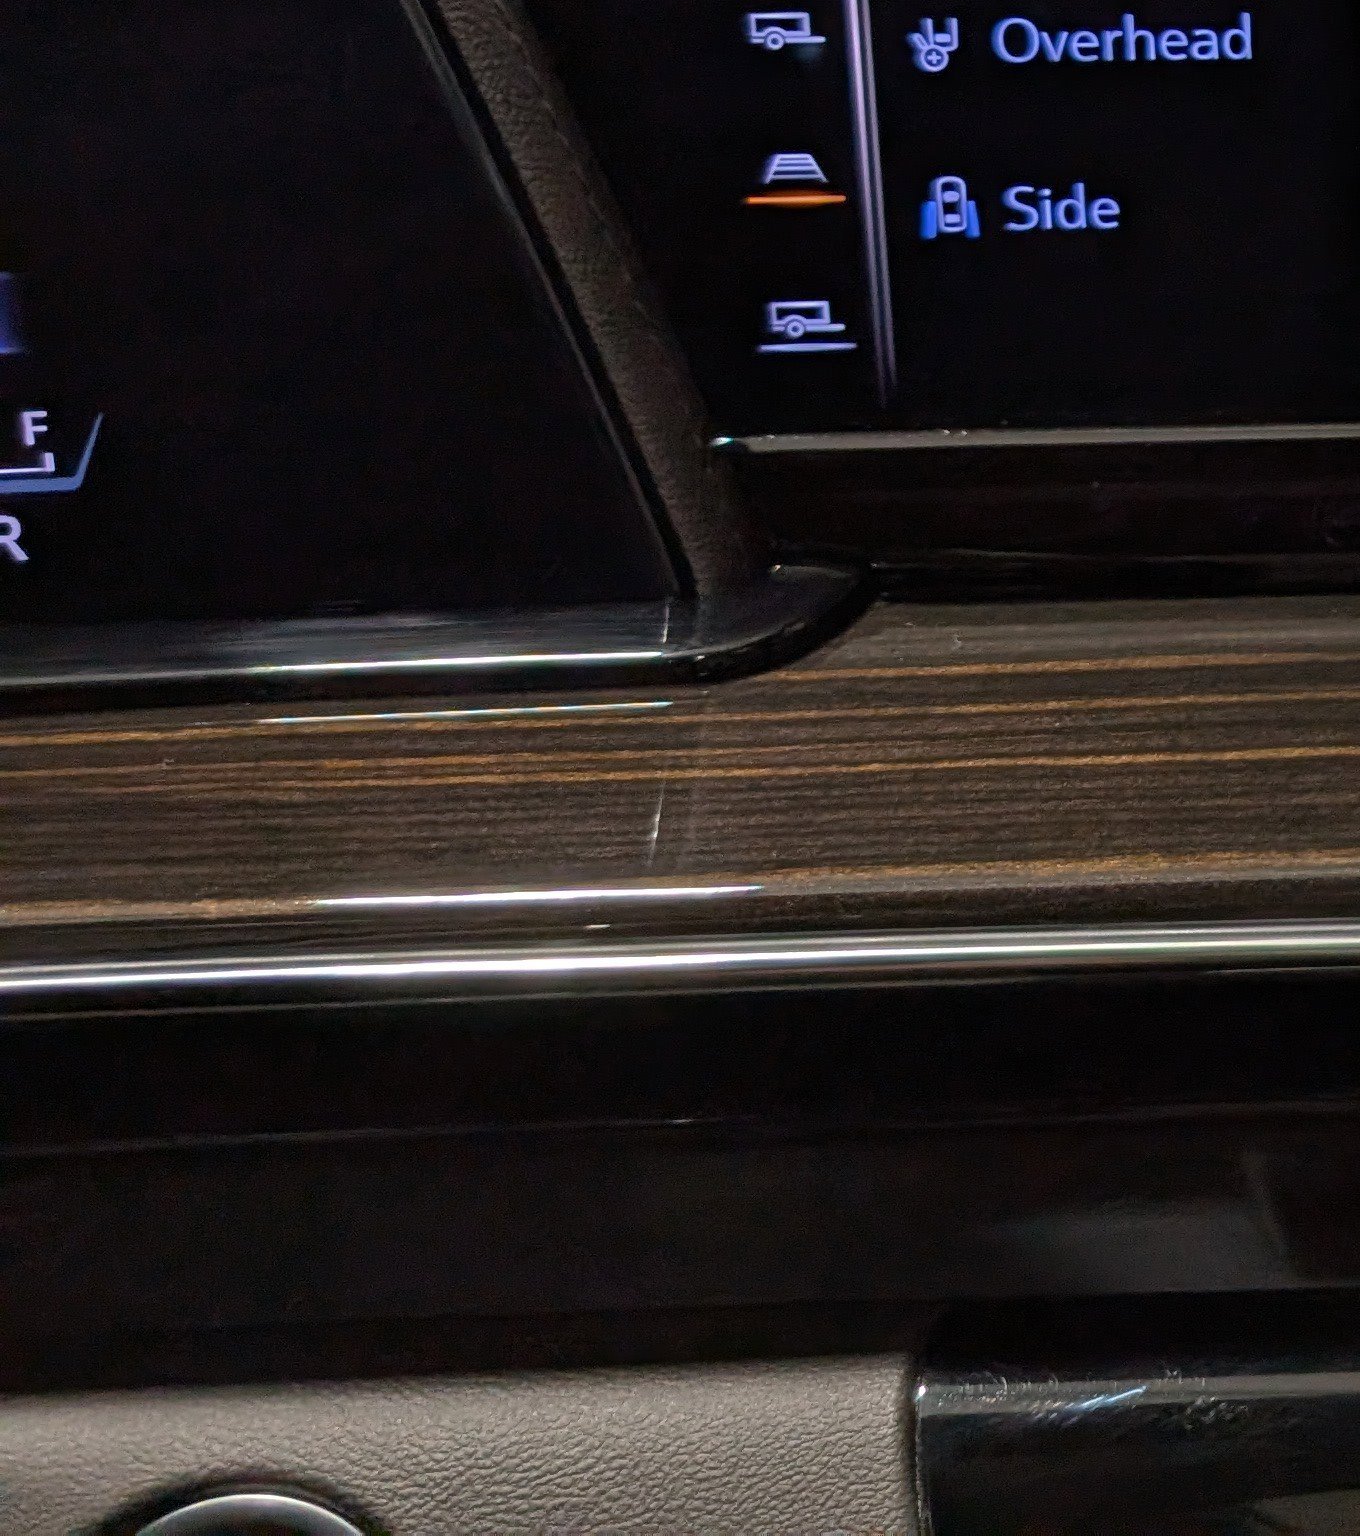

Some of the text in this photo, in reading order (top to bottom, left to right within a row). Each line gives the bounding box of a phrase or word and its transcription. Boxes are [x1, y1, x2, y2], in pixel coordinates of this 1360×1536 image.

[992, 12, 1253, 64] Overhead
[1003, 182, 1121, 231] Side
[21, 411, 48, 446] F
[0, 515, 29, 561] R
